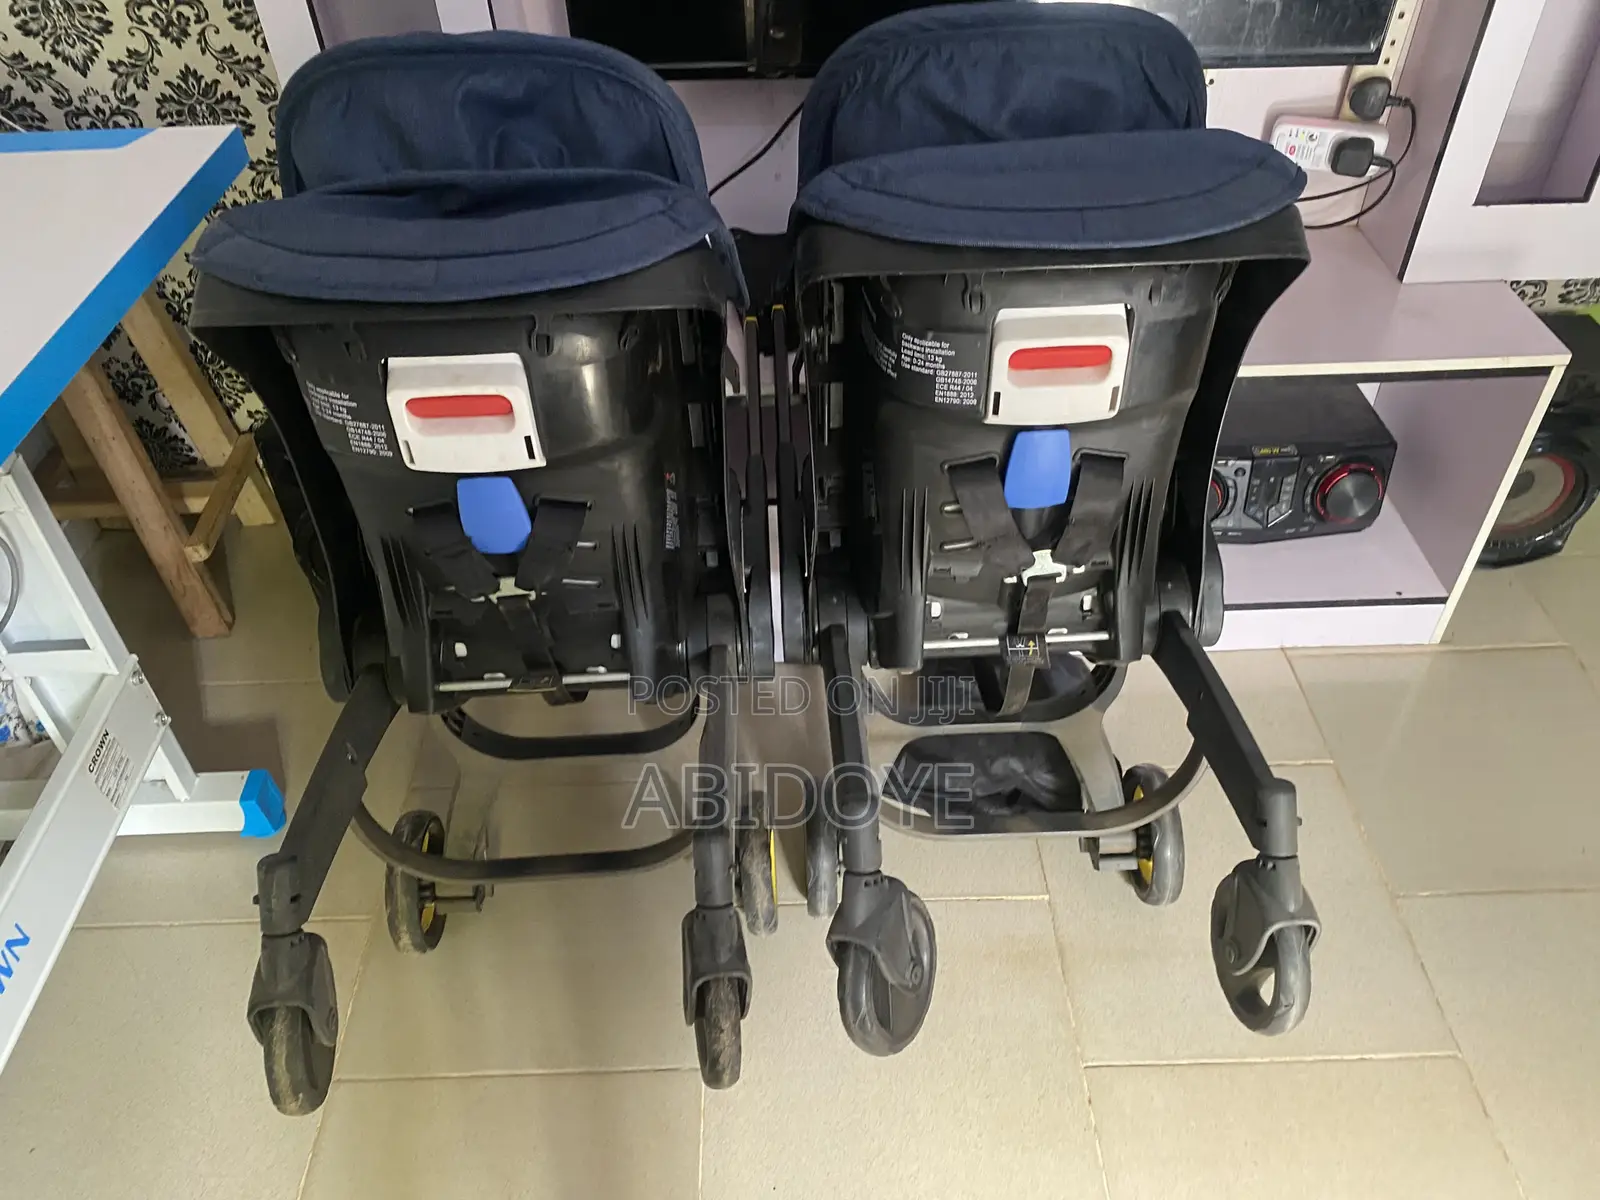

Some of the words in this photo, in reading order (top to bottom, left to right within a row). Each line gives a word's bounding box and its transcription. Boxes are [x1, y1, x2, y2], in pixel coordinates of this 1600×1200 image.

[901, 332, 913, 344] Only
[914, 338, 940, 348] applicable
[941, 341, 950, 349] for
[901, 347, 913, 356] Load
[935, 356, 943, 364] kg
[925, 347, 956, 356] installation
[912, 358, 924, 366] 0-24
[925, 361, 945, 370] months
[935, 383, 948, 391] ECE
[88, 728, 109, 774] CROWN
